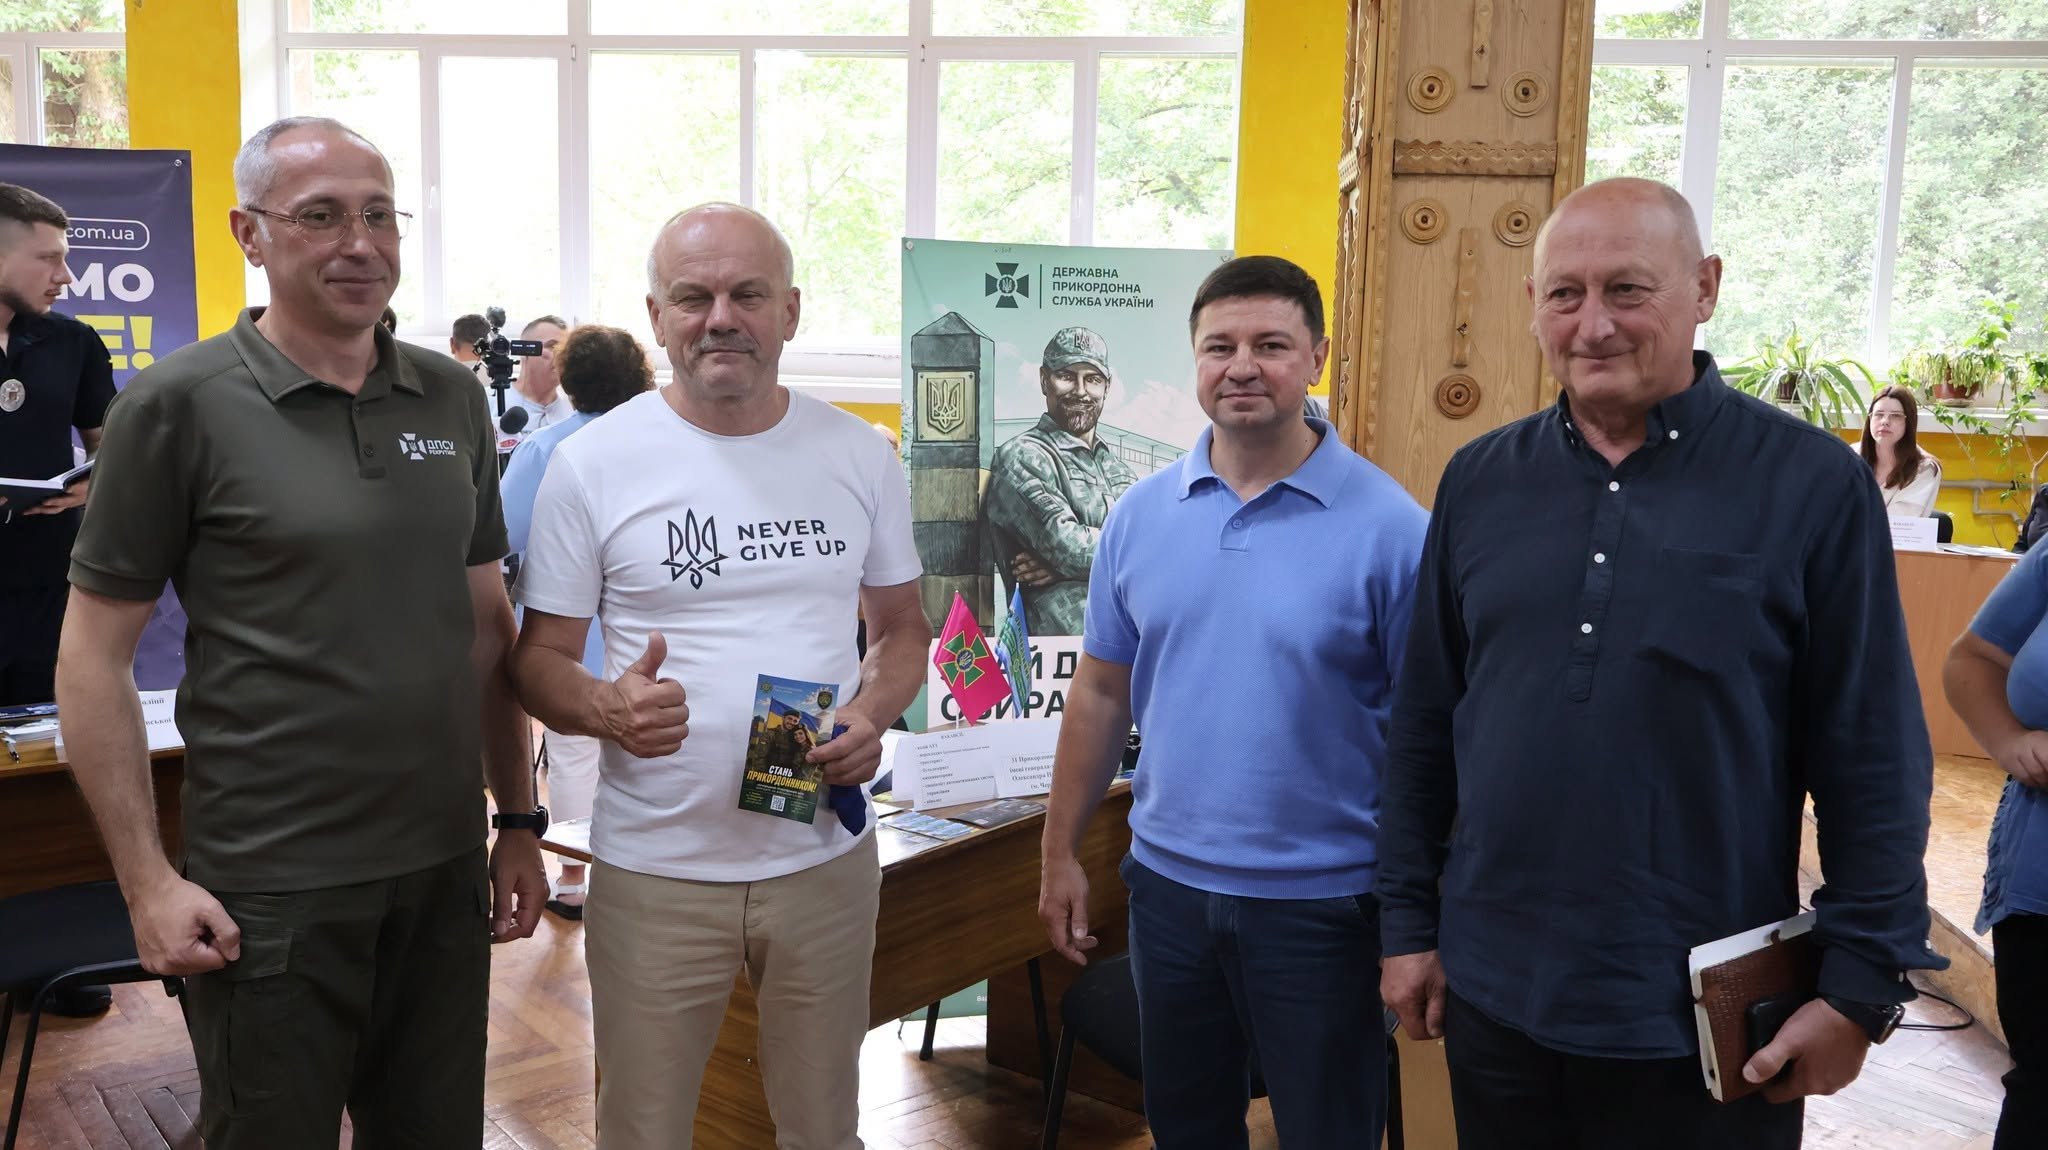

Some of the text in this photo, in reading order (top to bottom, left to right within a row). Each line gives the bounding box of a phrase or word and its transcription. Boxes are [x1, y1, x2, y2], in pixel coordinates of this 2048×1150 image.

[1052, 266, 1119, 279] ДЕРЖАВНА
[1052, 281, 1141, 294] ПРИКОРДОННА
[1052, 295, 1154, 308] СЛУЖБА УКРАЇНИ
[426, 440, 454, 450] ДПСУ
[737, 519, 827, 541] NEVER
[740, 539, 847, 562] GIVE UP
[768, 765, 793, 778] СТАНЬ
[746, 769, 818, 793] ПРИКОРДОННИКОМ!
